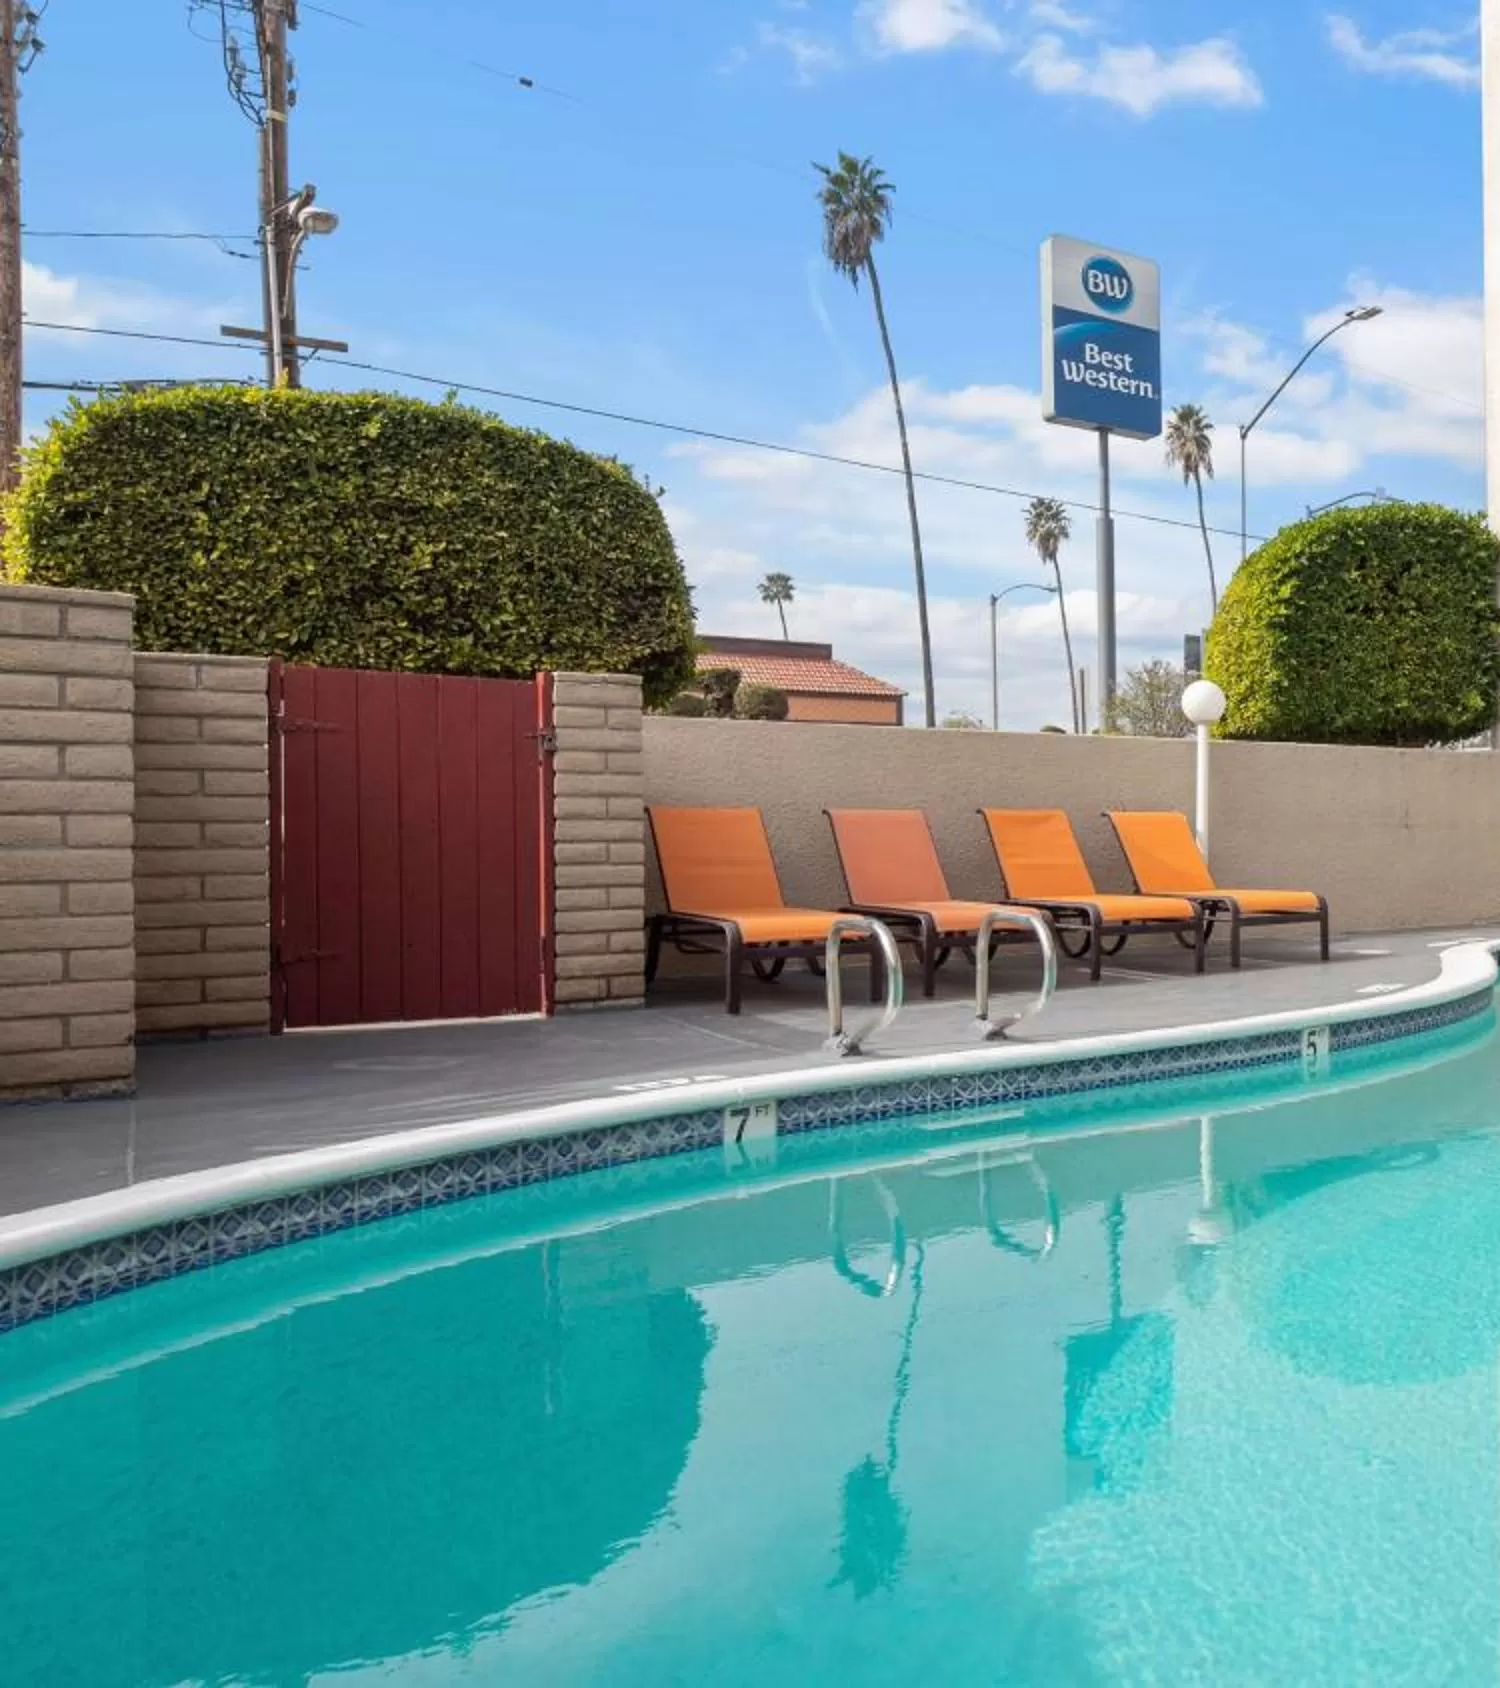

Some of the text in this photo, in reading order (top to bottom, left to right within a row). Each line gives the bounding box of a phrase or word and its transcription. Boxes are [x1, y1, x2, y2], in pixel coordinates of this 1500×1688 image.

[1088, 269, 1128, 299] BW
[1085, 342, 1134, 373] Best
[1062, 359, 1153, 399] Western
[1306, 1030, 1318, 1058] 5
[729, 1103, 770, 1145] 7 FT
